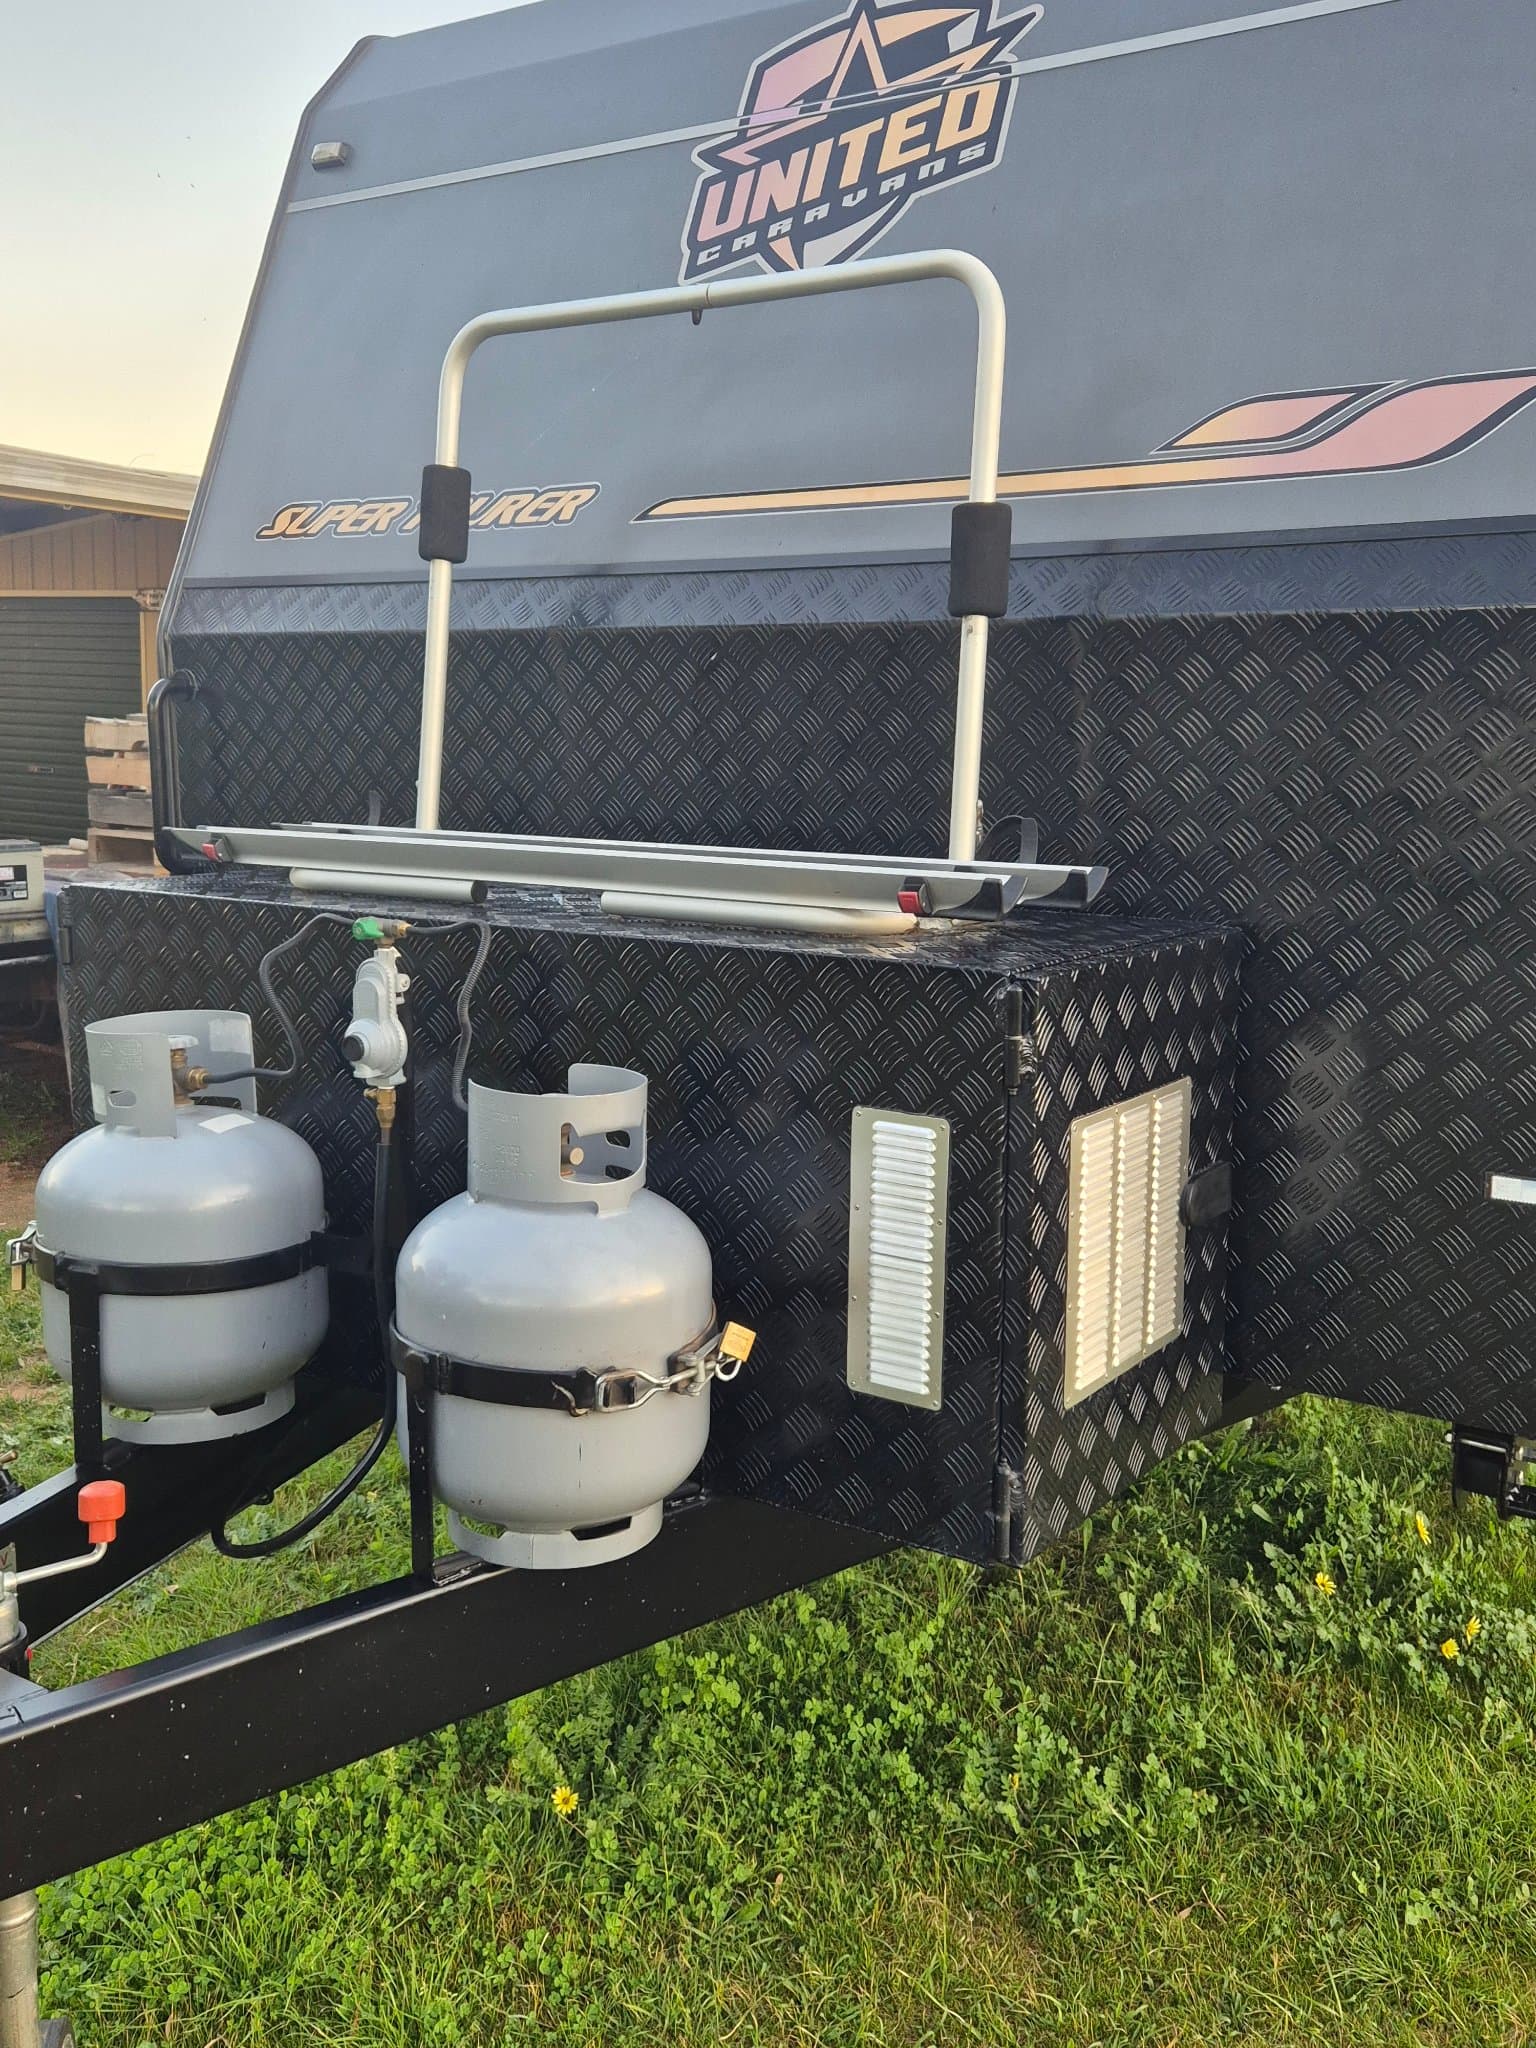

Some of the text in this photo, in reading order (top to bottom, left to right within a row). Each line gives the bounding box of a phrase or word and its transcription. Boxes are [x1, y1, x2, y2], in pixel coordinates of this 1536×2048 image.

[696, 72, 1001, 242] UNITED
[258, 487, 598, 537] SUPER URER
